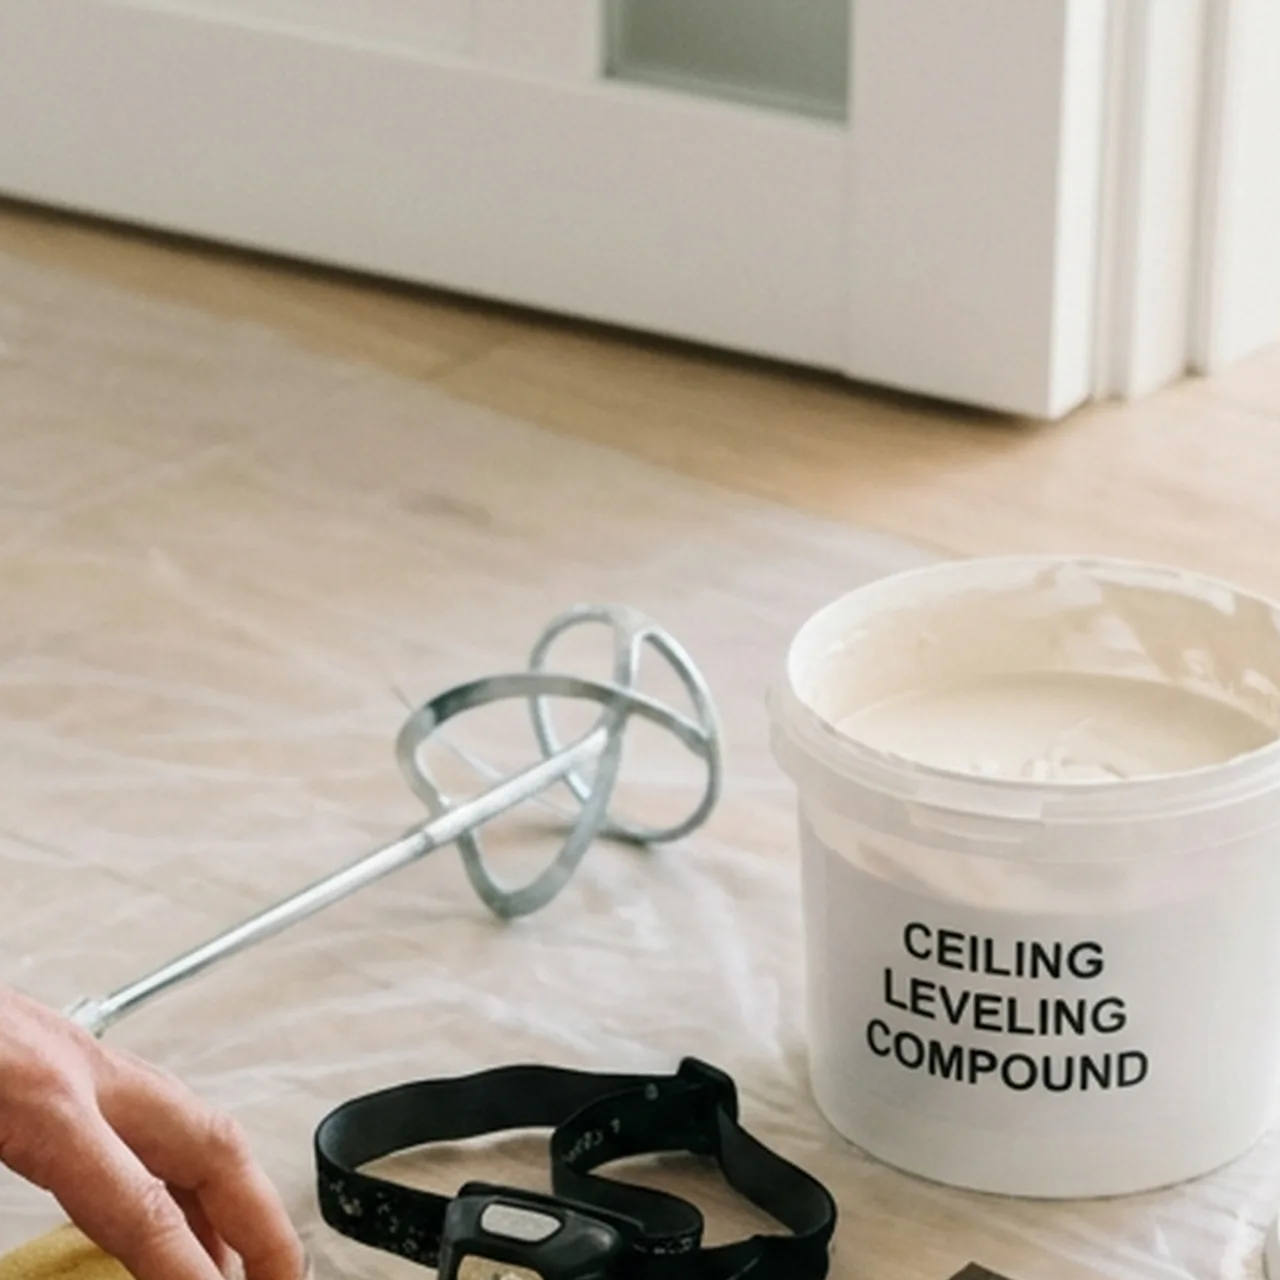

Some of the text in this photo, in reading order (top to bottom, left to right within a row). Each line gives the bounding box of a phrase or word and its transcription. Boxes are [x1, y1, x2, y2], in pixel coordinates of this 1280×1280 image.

[903, 921, 1105, 979] CEILING
[884, 967, 1127, 1036] LEVELING
[866, 1018, 1149, 1092] COMPOUND
